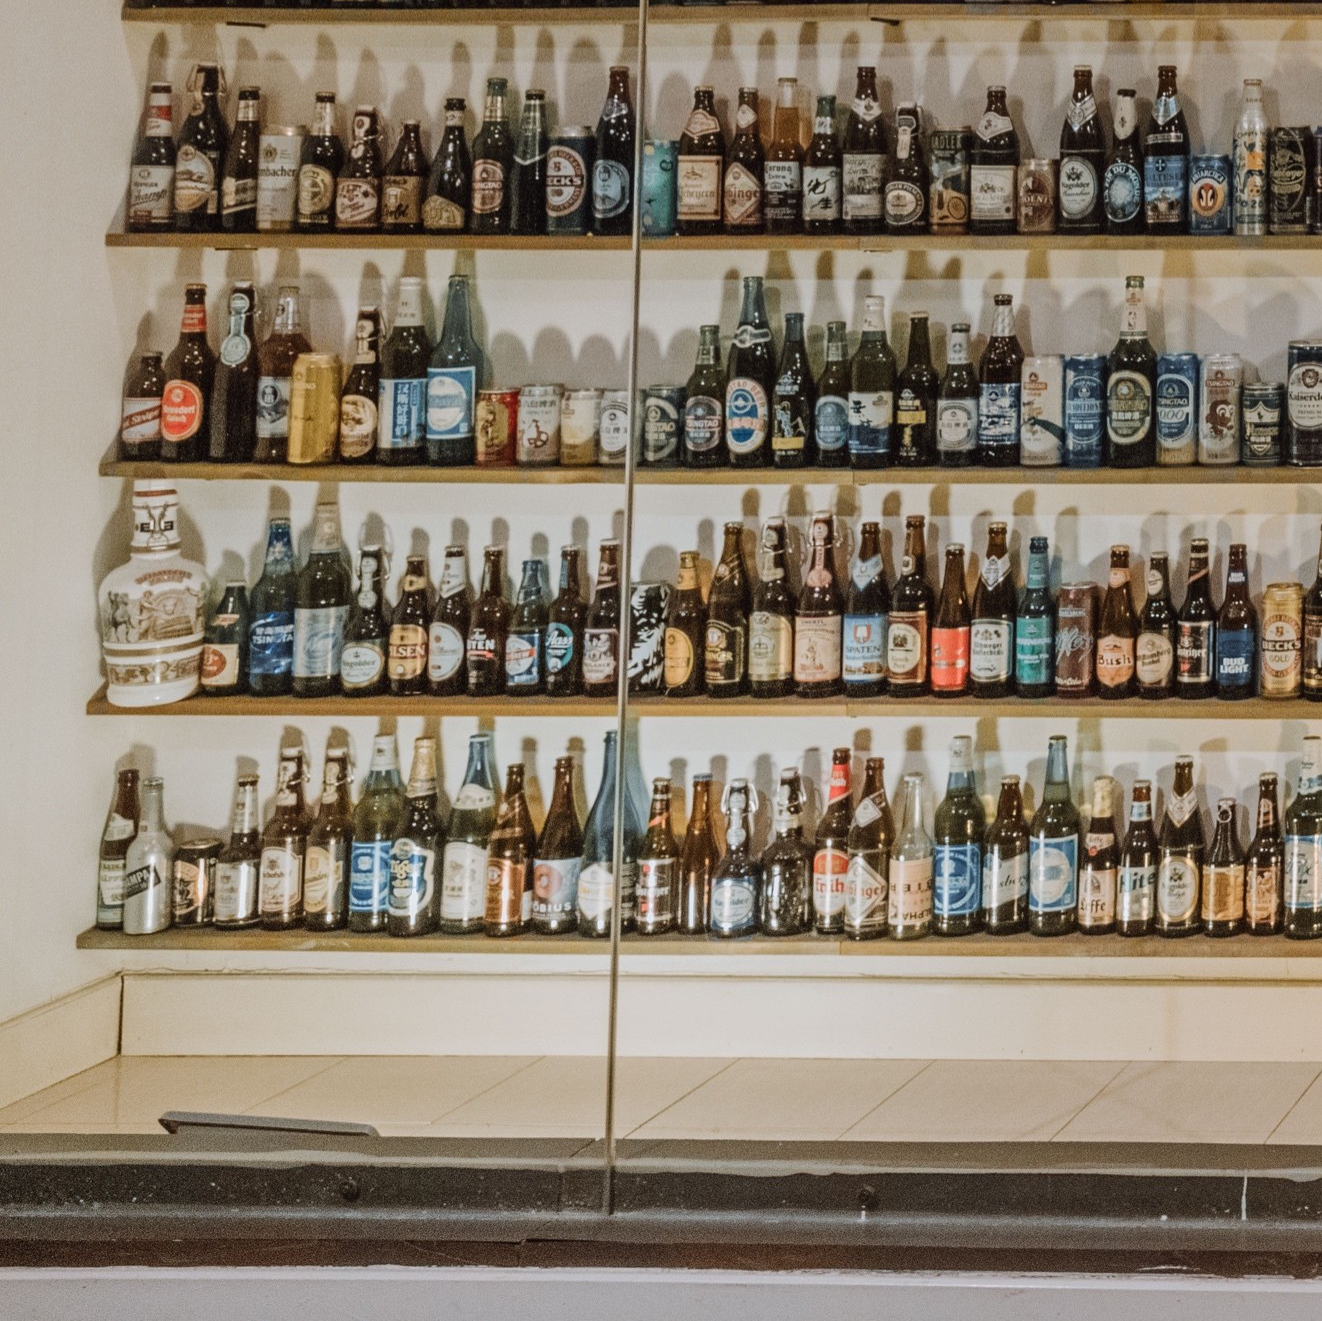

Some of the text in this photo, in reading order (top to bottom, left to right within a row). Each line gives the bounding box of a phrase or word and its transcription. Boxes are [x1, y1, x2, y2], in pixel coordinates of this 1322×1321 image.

[845, 645, 880, 654] SPATEN
[1098, 654, 1132, 666] Bush
[1222, 657, 1245, 666] BUD
[1219, 664, 1249, 673] LIGHT
